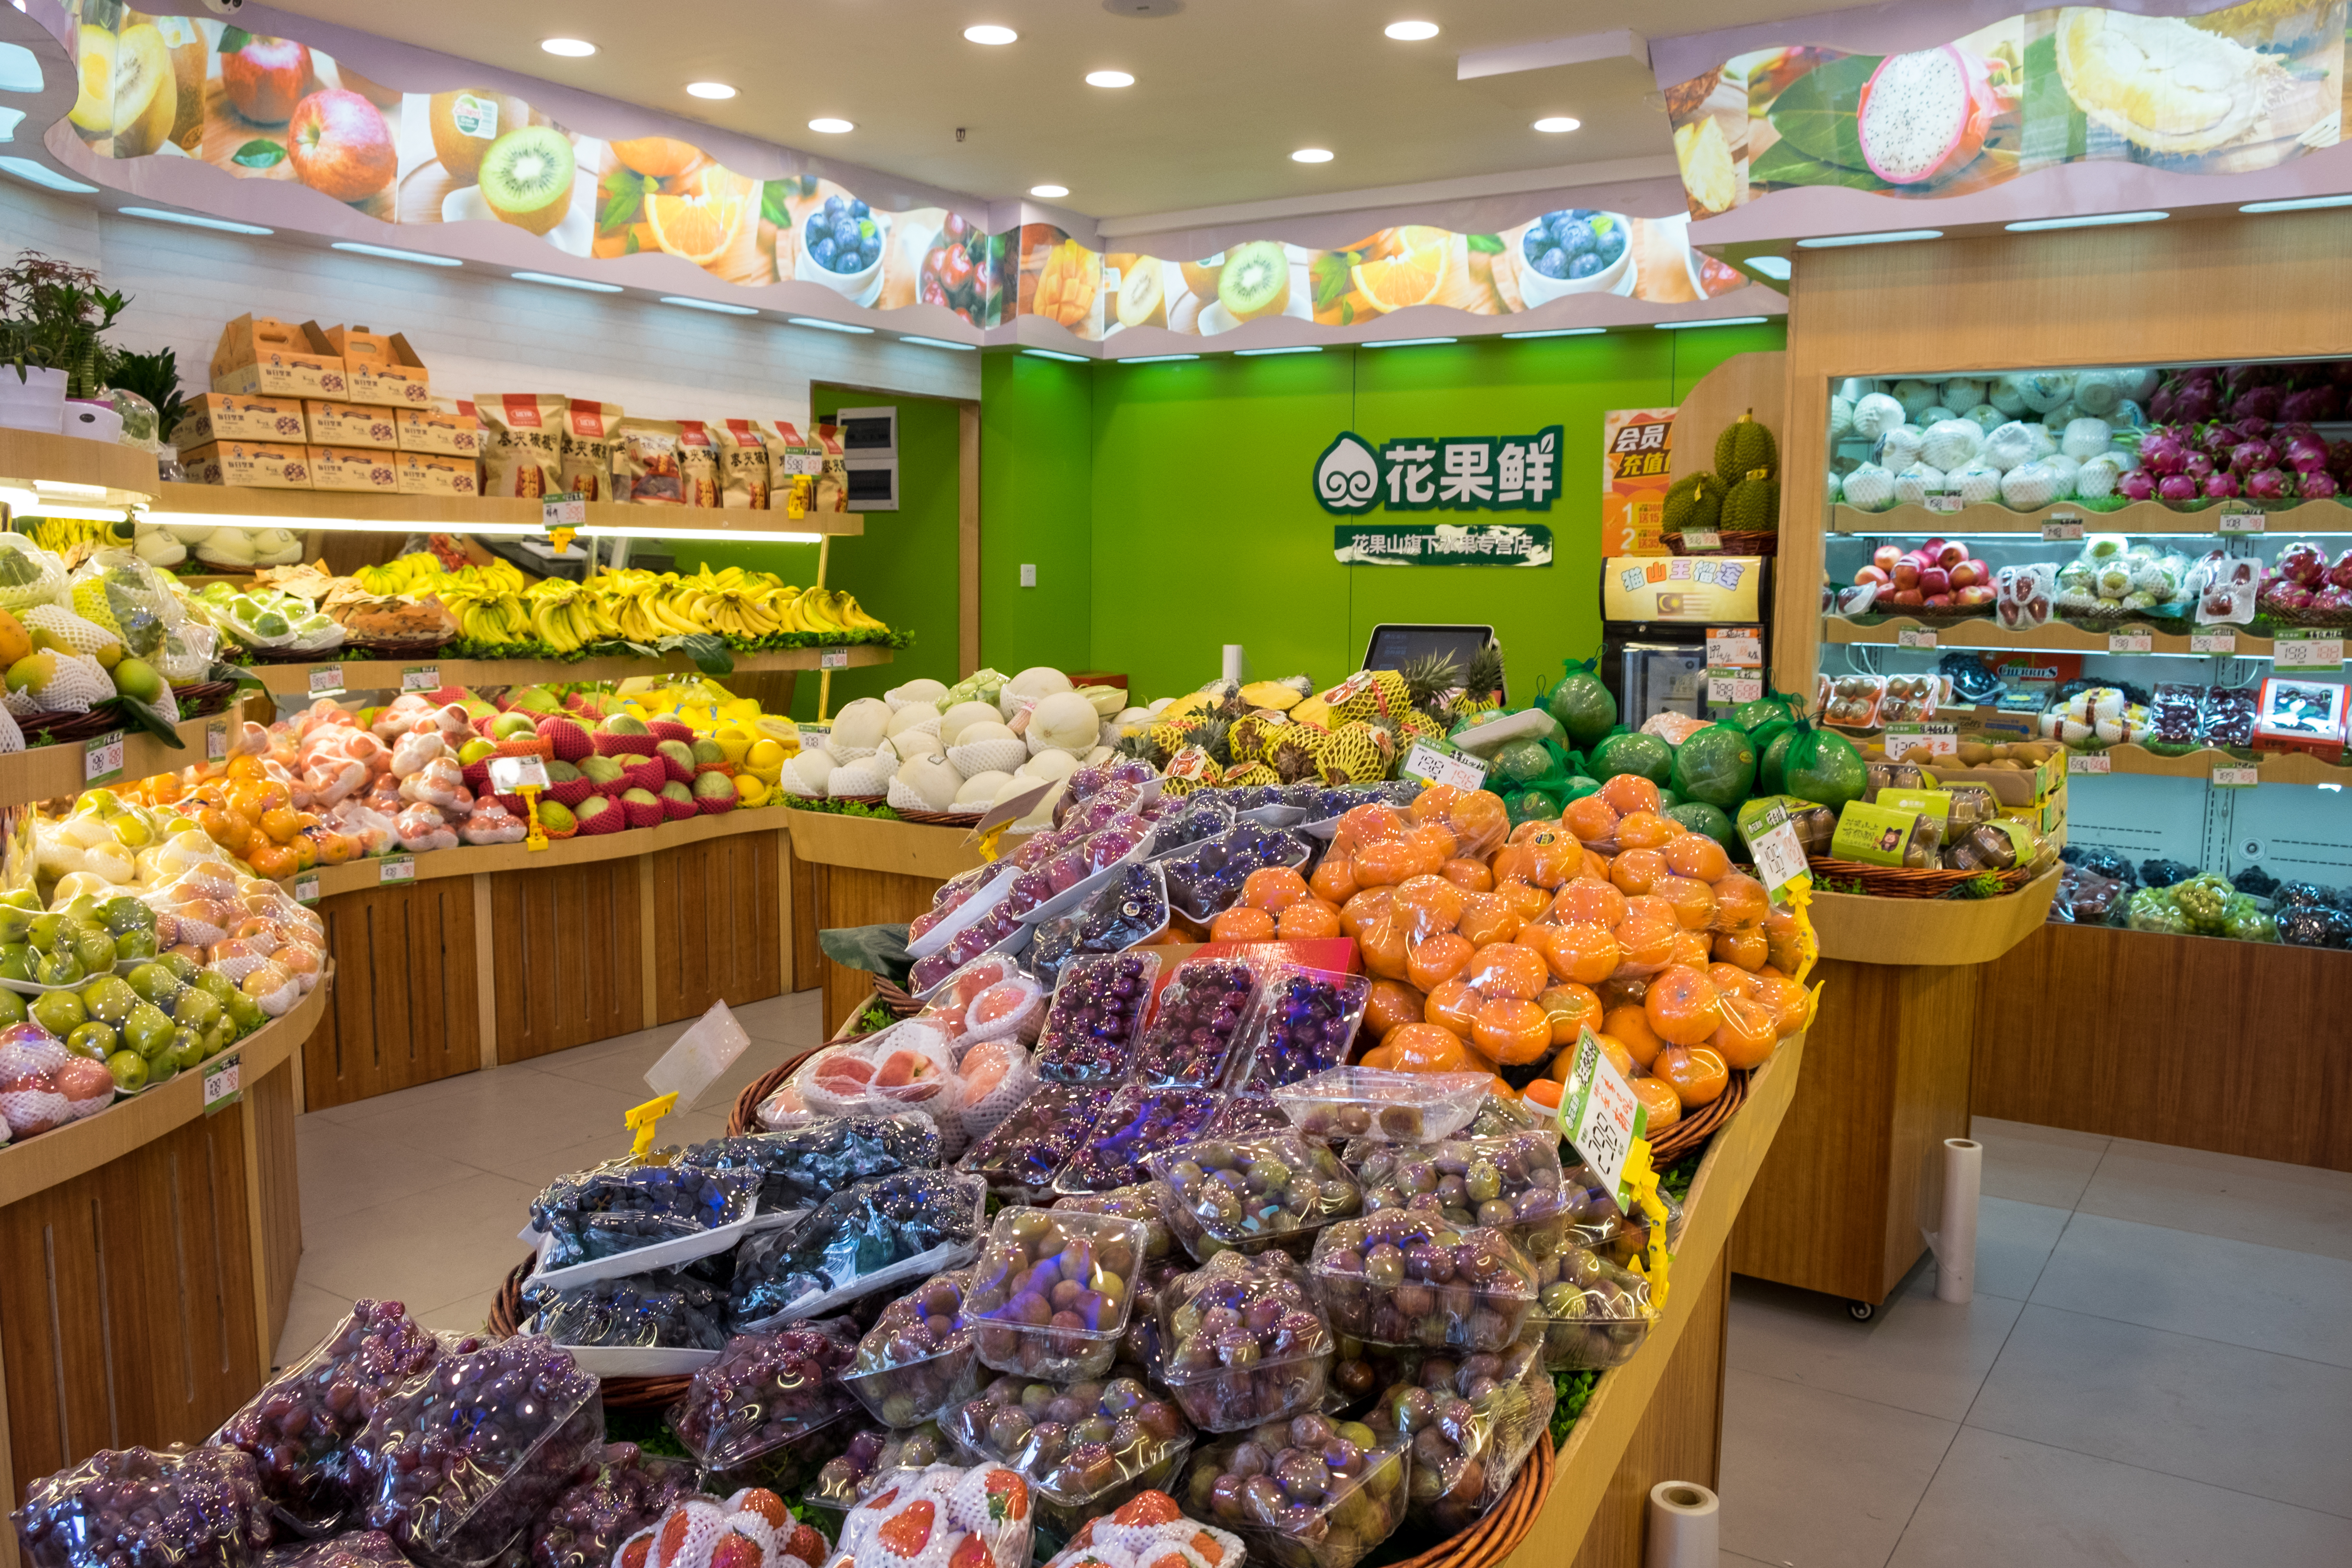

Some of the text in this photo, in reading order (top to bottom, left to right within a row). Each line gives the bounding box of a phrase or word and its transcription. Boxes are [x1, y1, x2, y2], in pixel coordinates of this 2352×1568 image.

[1615, 424, 1665, 453] 会员
[1385, 433, 1554, 502] 花果鲜
[1622, 502, 1632, 524] 1
[1351, 534, 1533, 554] 花果山旗下水果专营店
[1621, 528, 1635, 550] 2
[1621, 559, 1745, 591] 猫山王榴莲
[1417, 754, 1444, 775] 19.8
[1568, 1093, 1581, 1121] 花果鲜
[1588, 1111, 1618, 1175] 29.8
